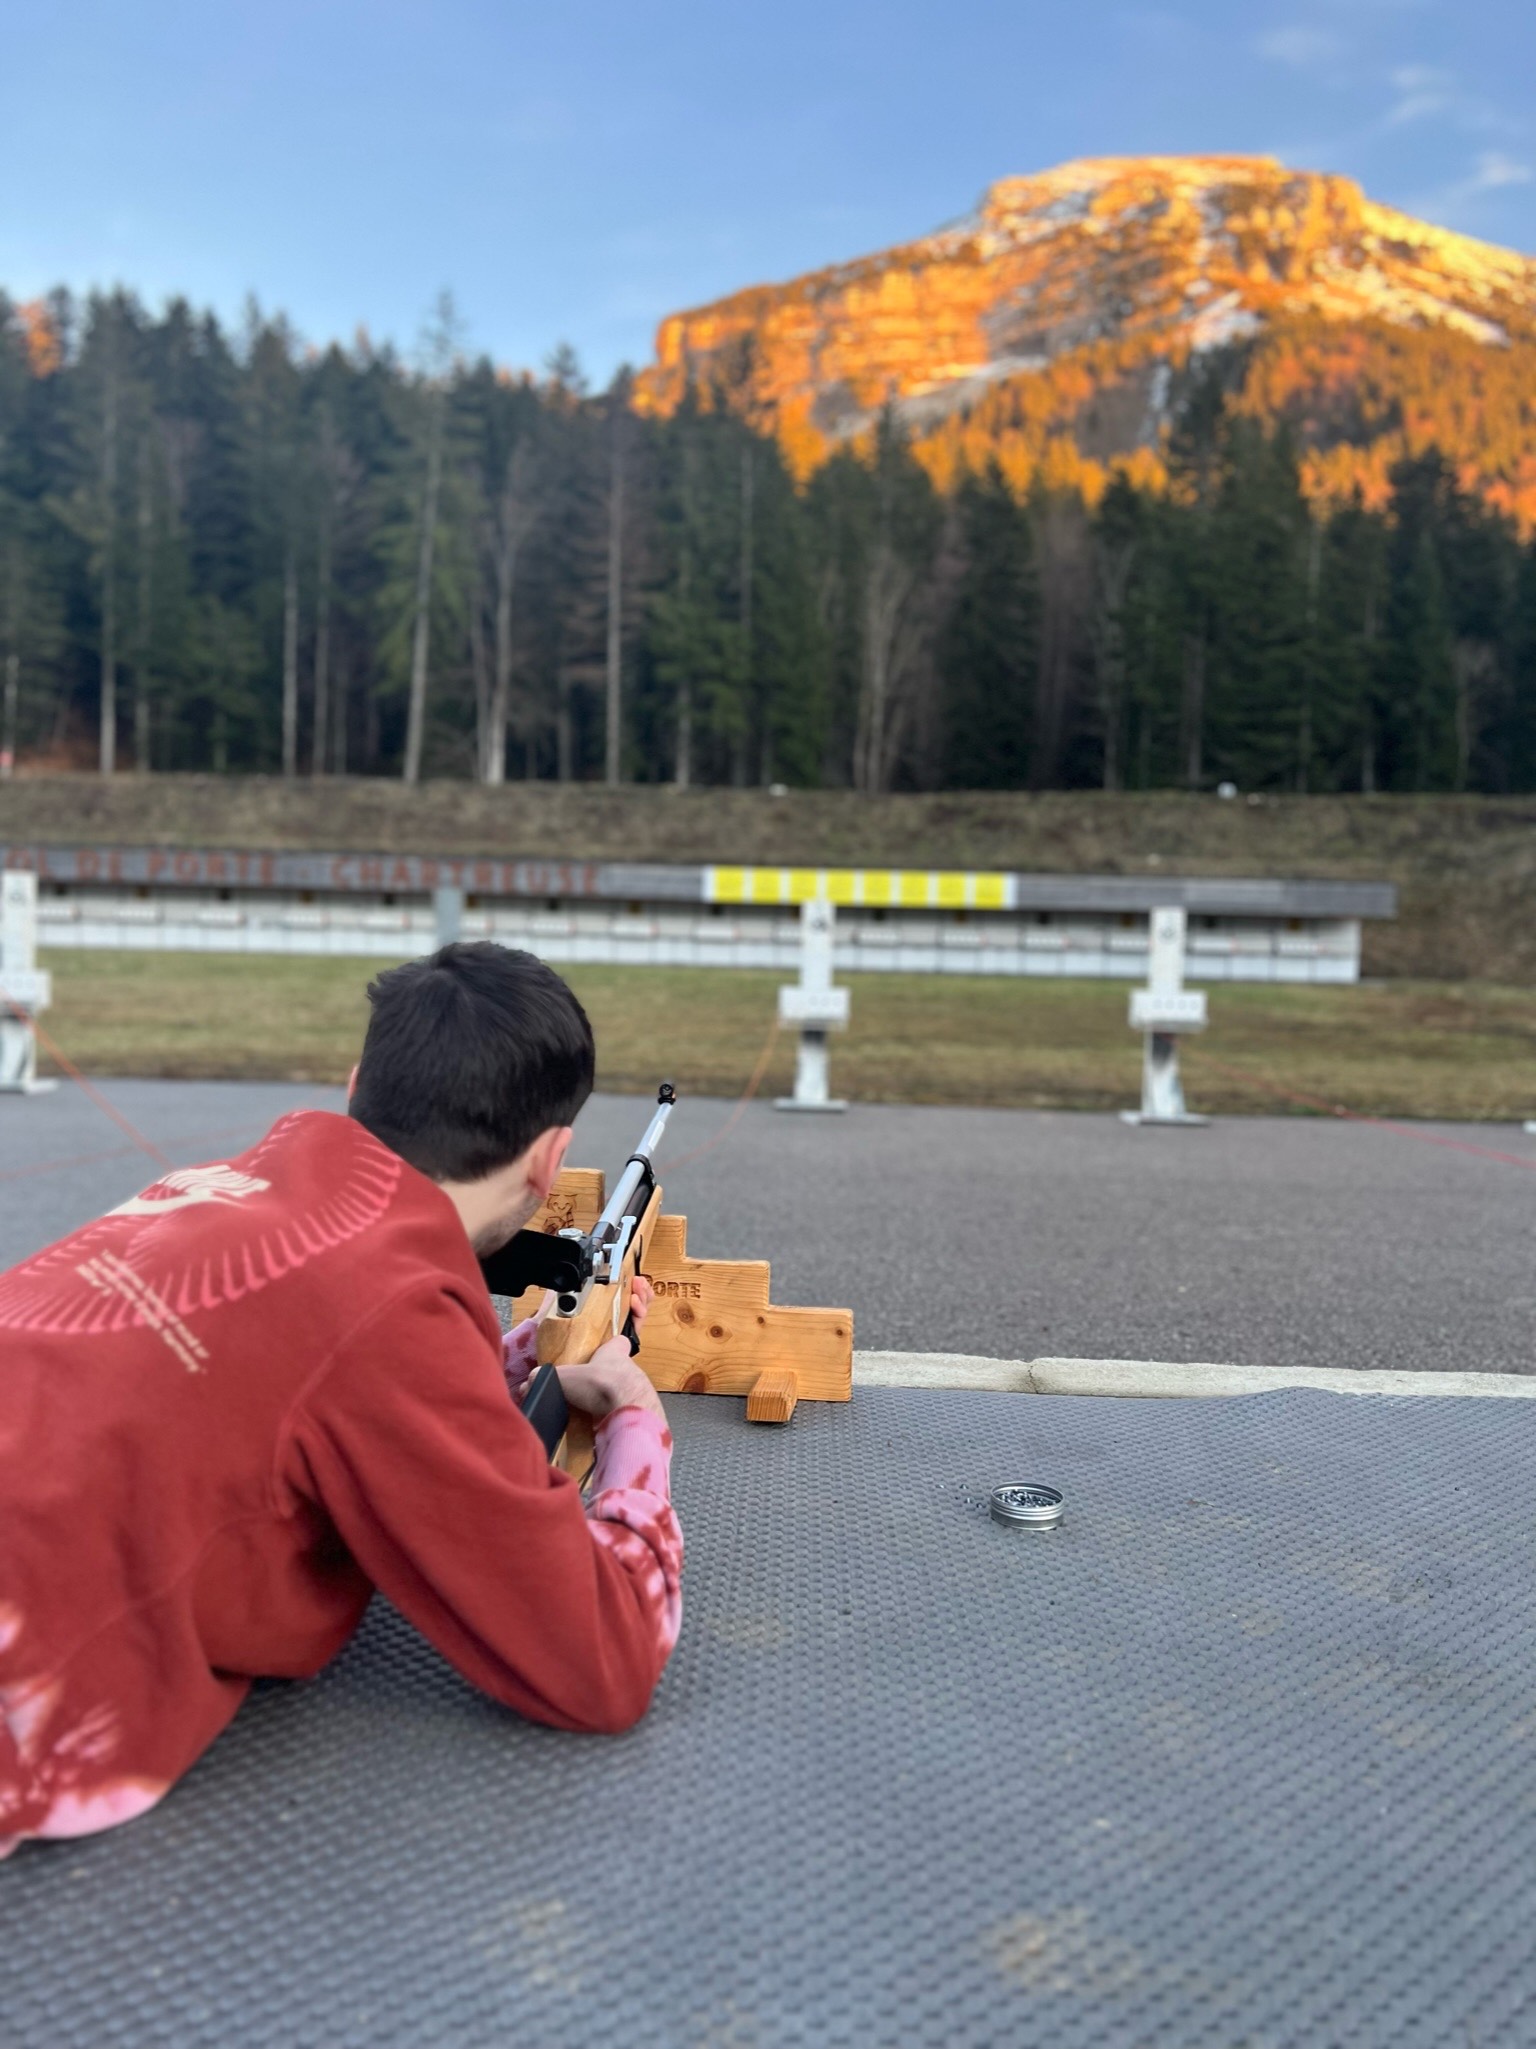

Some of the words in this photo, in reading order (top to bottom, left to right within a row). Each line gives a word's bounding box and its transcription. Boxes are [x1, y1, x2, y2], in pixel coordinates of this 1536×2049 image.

[75, 850, 123, 882] DE
[146, 851, 276, 887] PORTE
[330, 856, 599, 894] CHARTREUSE
